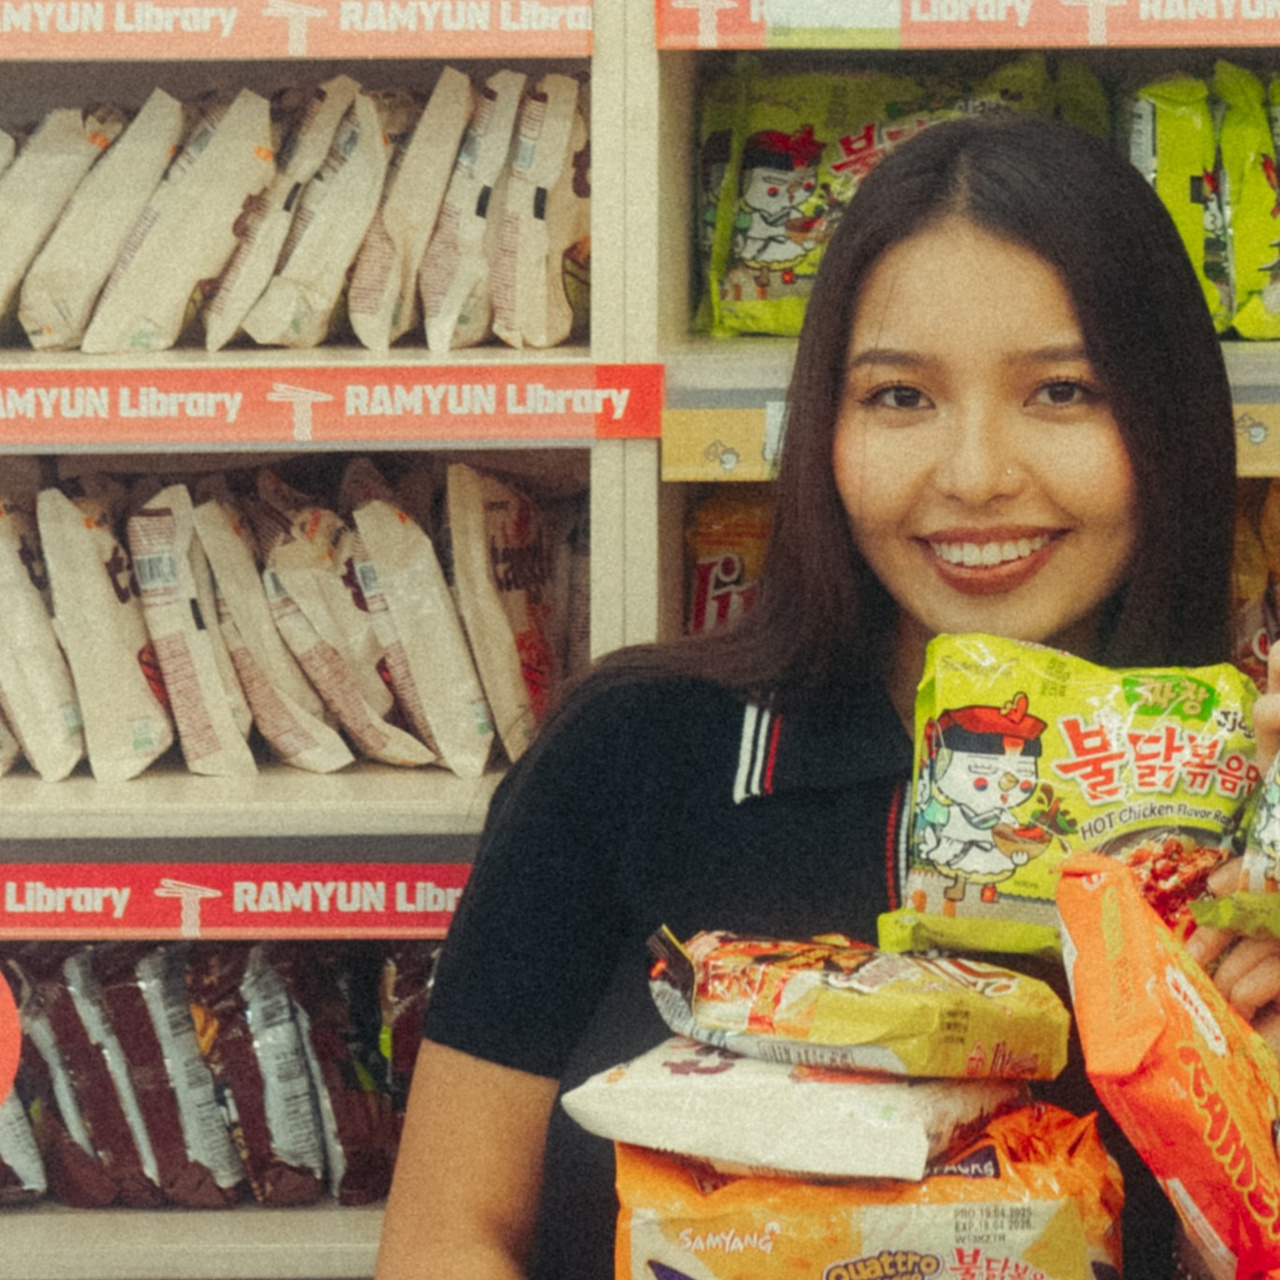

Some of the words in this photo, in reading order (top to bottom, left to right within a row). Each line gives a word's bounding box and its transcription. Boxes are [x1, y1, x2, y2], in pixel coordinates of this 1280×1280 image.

[0, 1, 104, 33] MYUN
[115, 0, 238, 37] Library
[340, 0, 490, 31] RAMYUN
[118, 385, 243, 423] Library
[346, 384, 496, 417] RAMYUN
[506, 383, 630, 419] Library
[1080, 811, 1115, 842] HOT
[1118, 802, 1175, 827] Chicken
[1176, 803, 1214, 821] Flavor
[4, 881, 131, 919] Library
[232, 880, 387, 913] RAMYUN
[679, 1226, 775, 1254] SAMYANG
